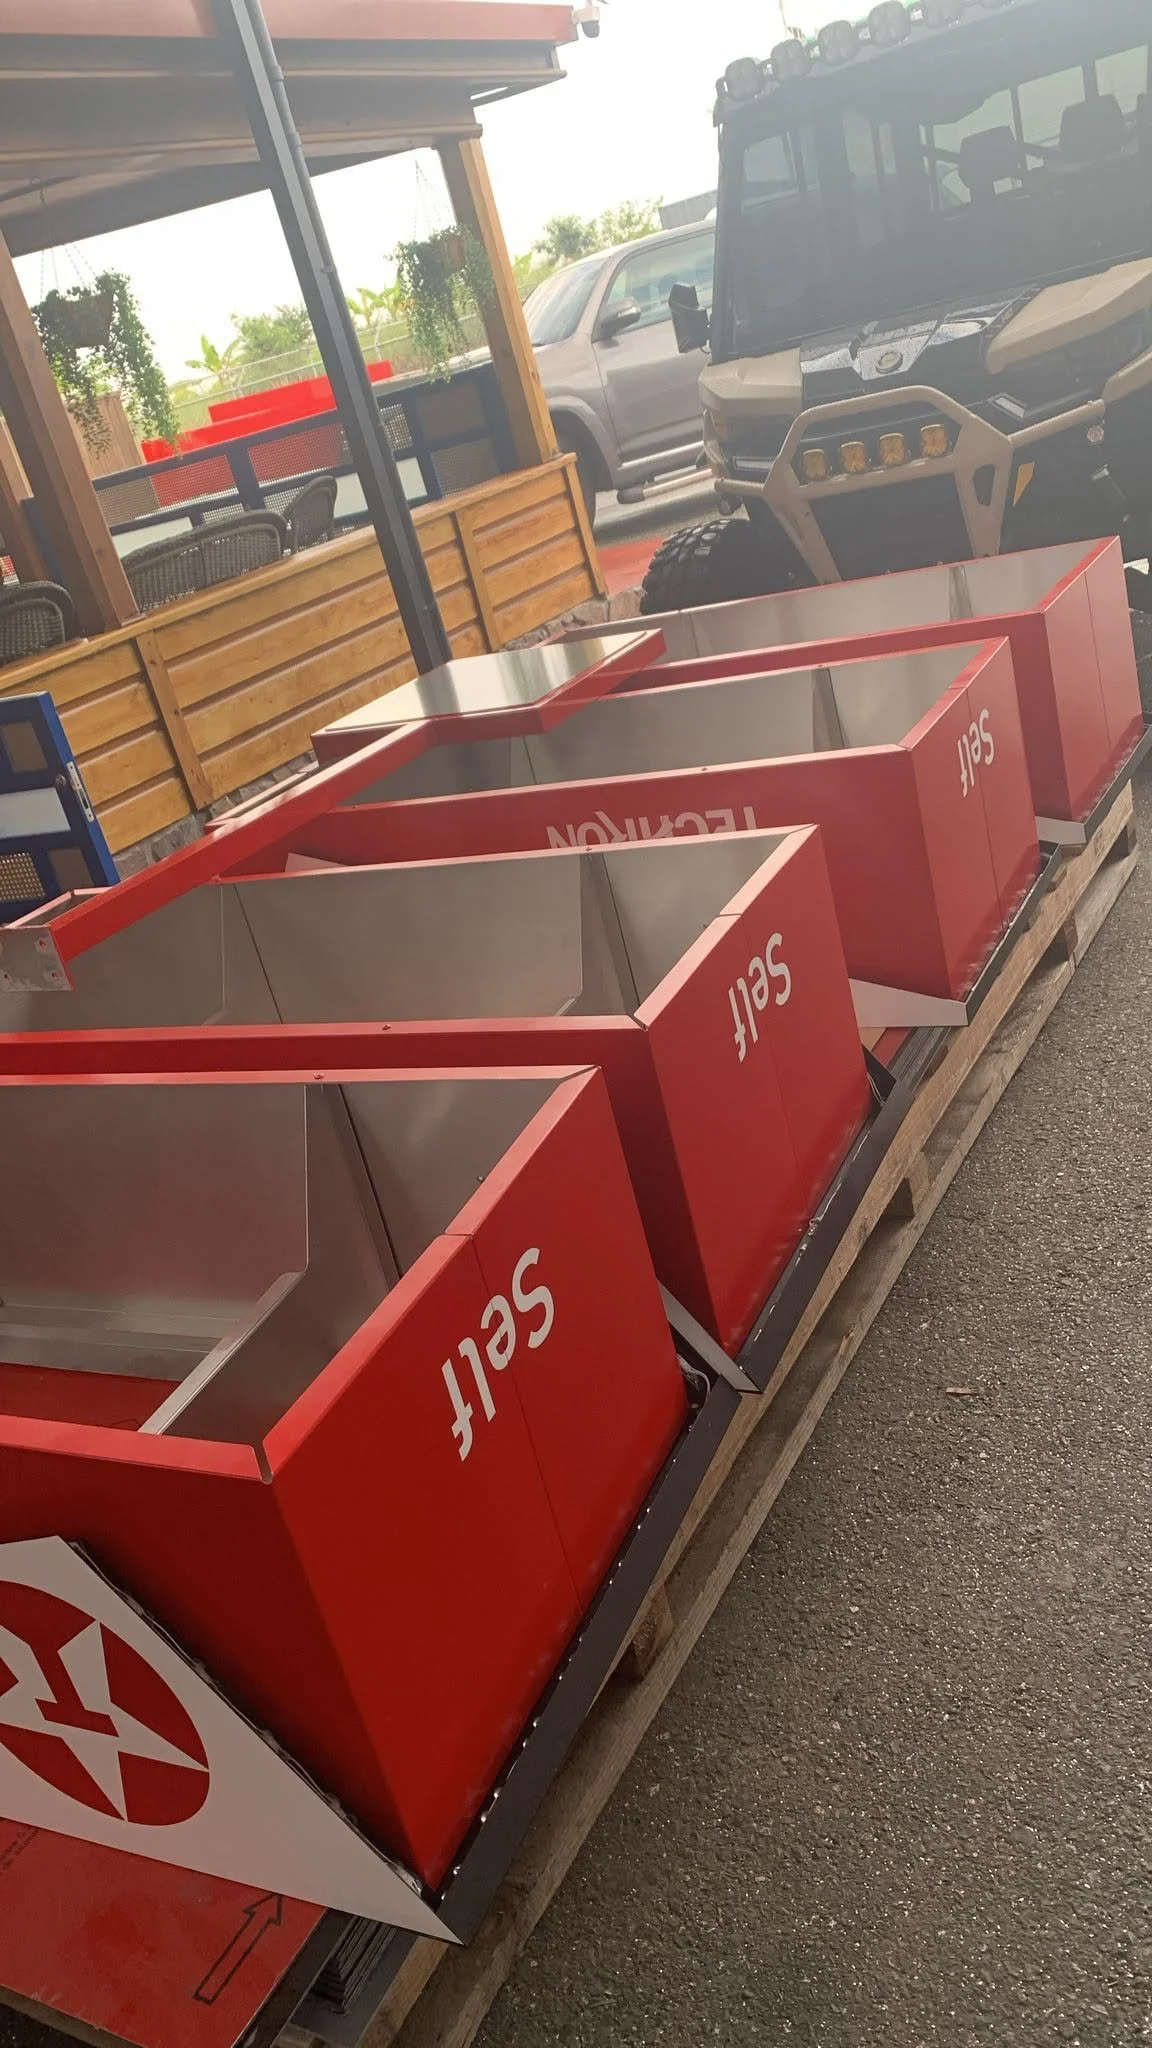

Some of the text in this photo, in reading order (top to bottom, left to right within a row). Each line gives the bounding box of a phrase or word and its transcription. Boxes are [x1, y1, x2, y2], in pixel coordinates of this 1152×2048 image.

[957, 708, 995, 798] Self
[729, 932, 792, 1062] Self
[441, 1247, 554, 1462] Self
